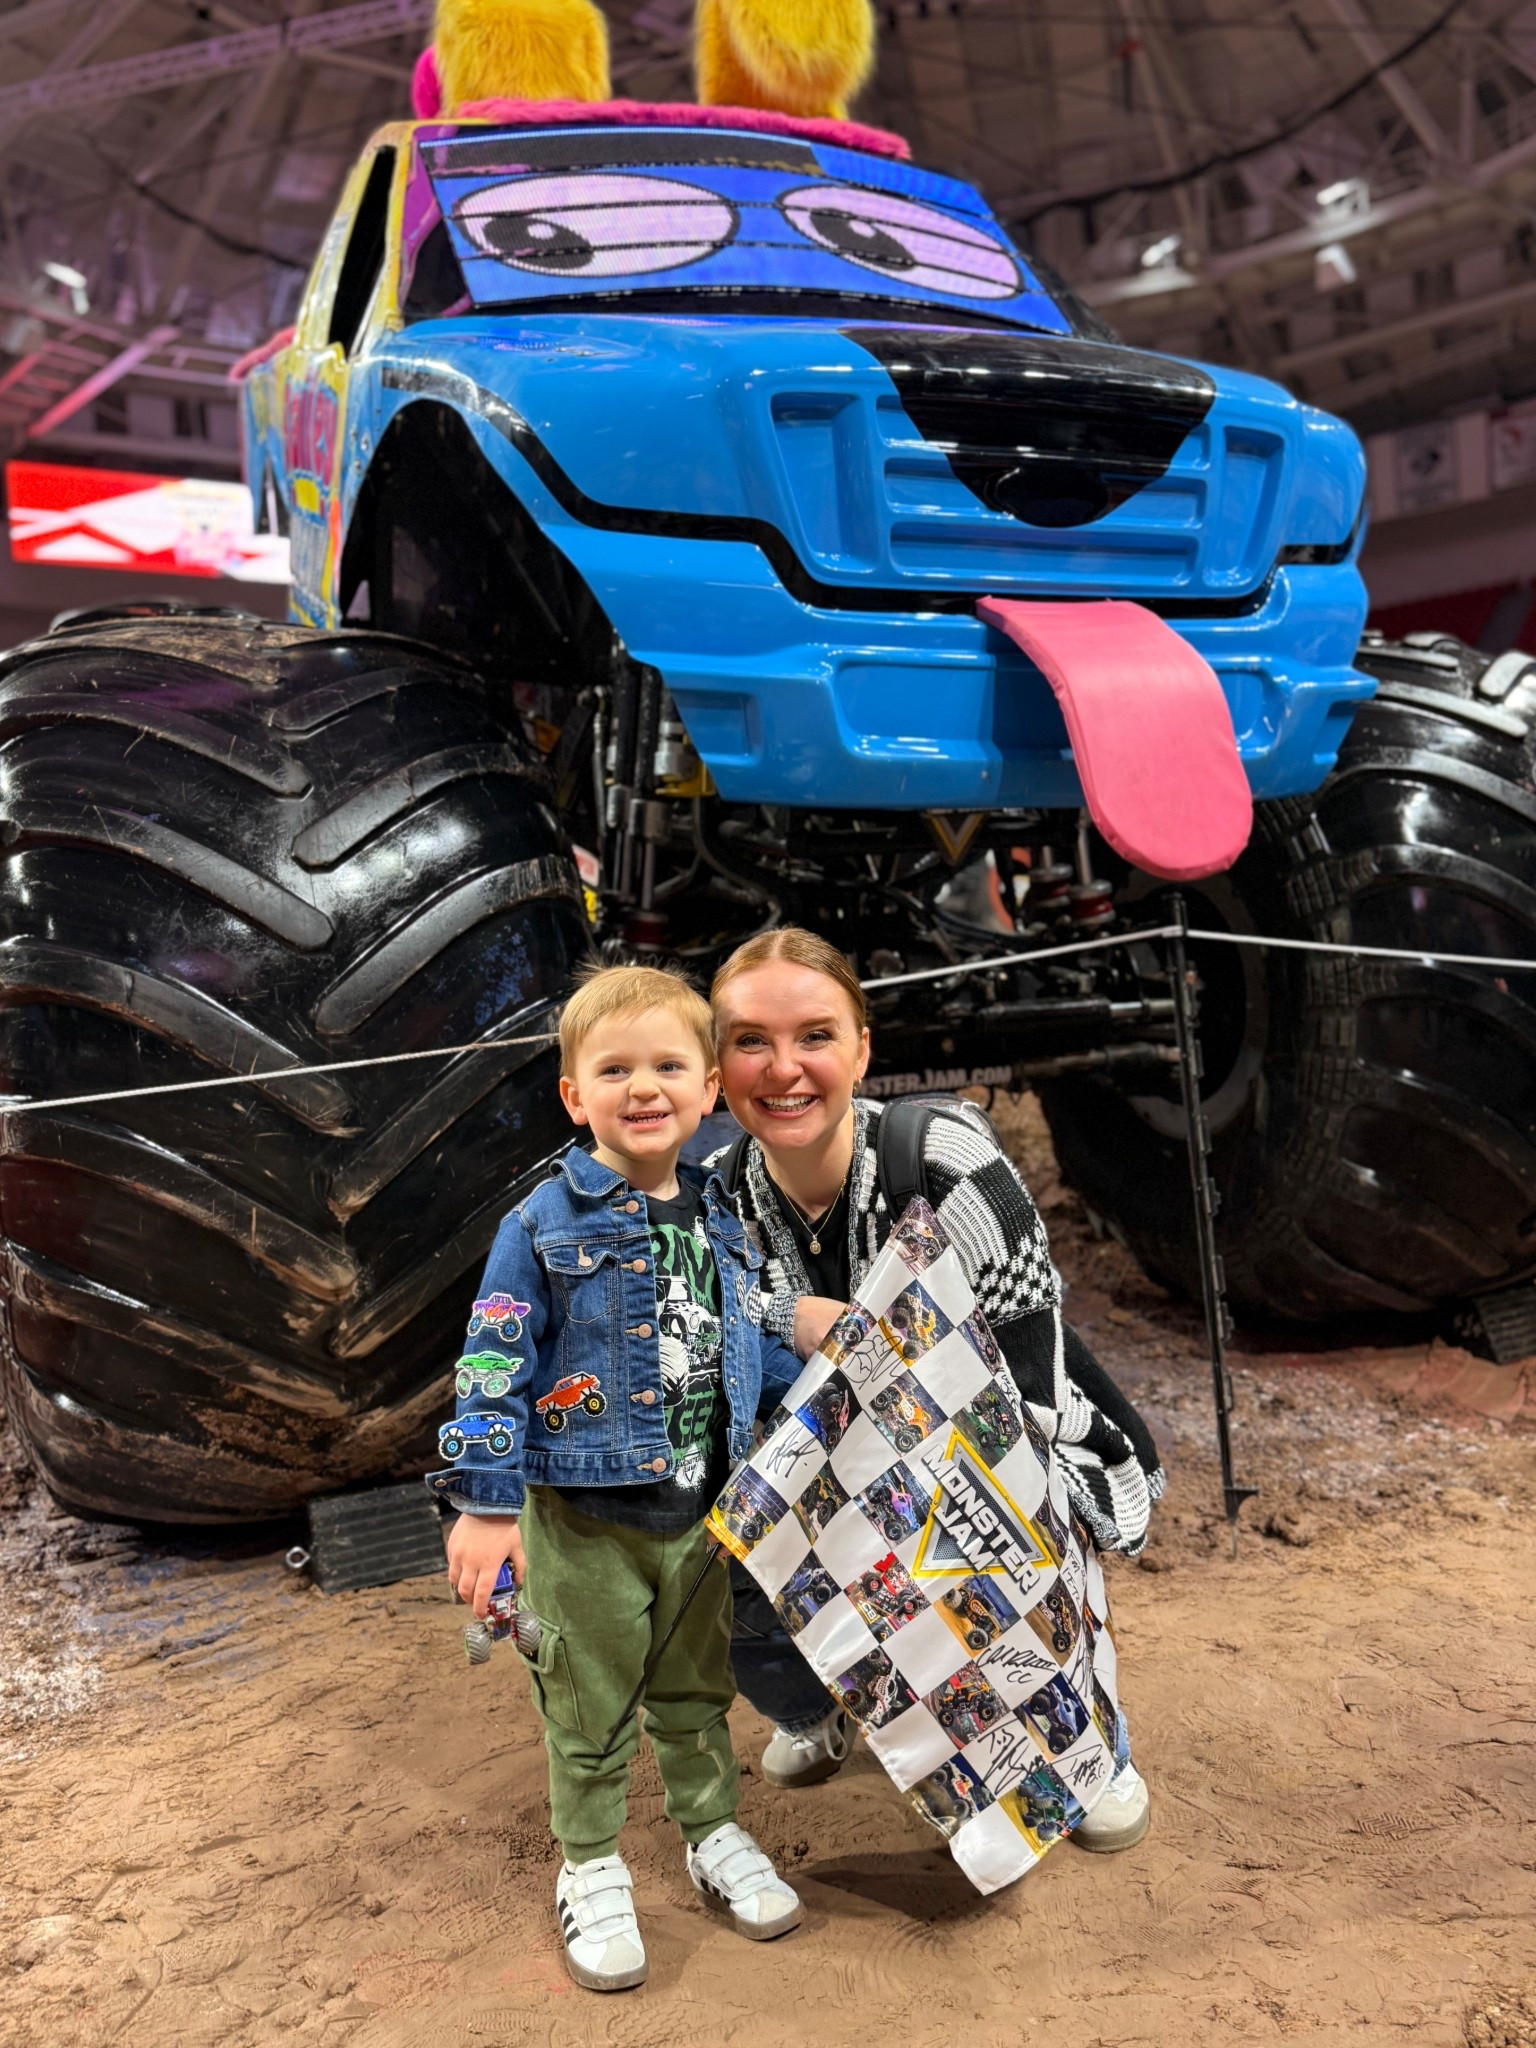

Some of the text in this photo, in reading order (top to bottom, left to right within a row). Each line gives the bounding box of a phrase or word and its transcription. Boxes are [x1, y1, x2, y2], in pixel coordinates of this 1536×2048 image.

[859, 1065, 1012, 1096] STERJAM.COM
[922, 1444, 1041, 1595] MONSTER
[933, 1506, 995, 1572] JAM
